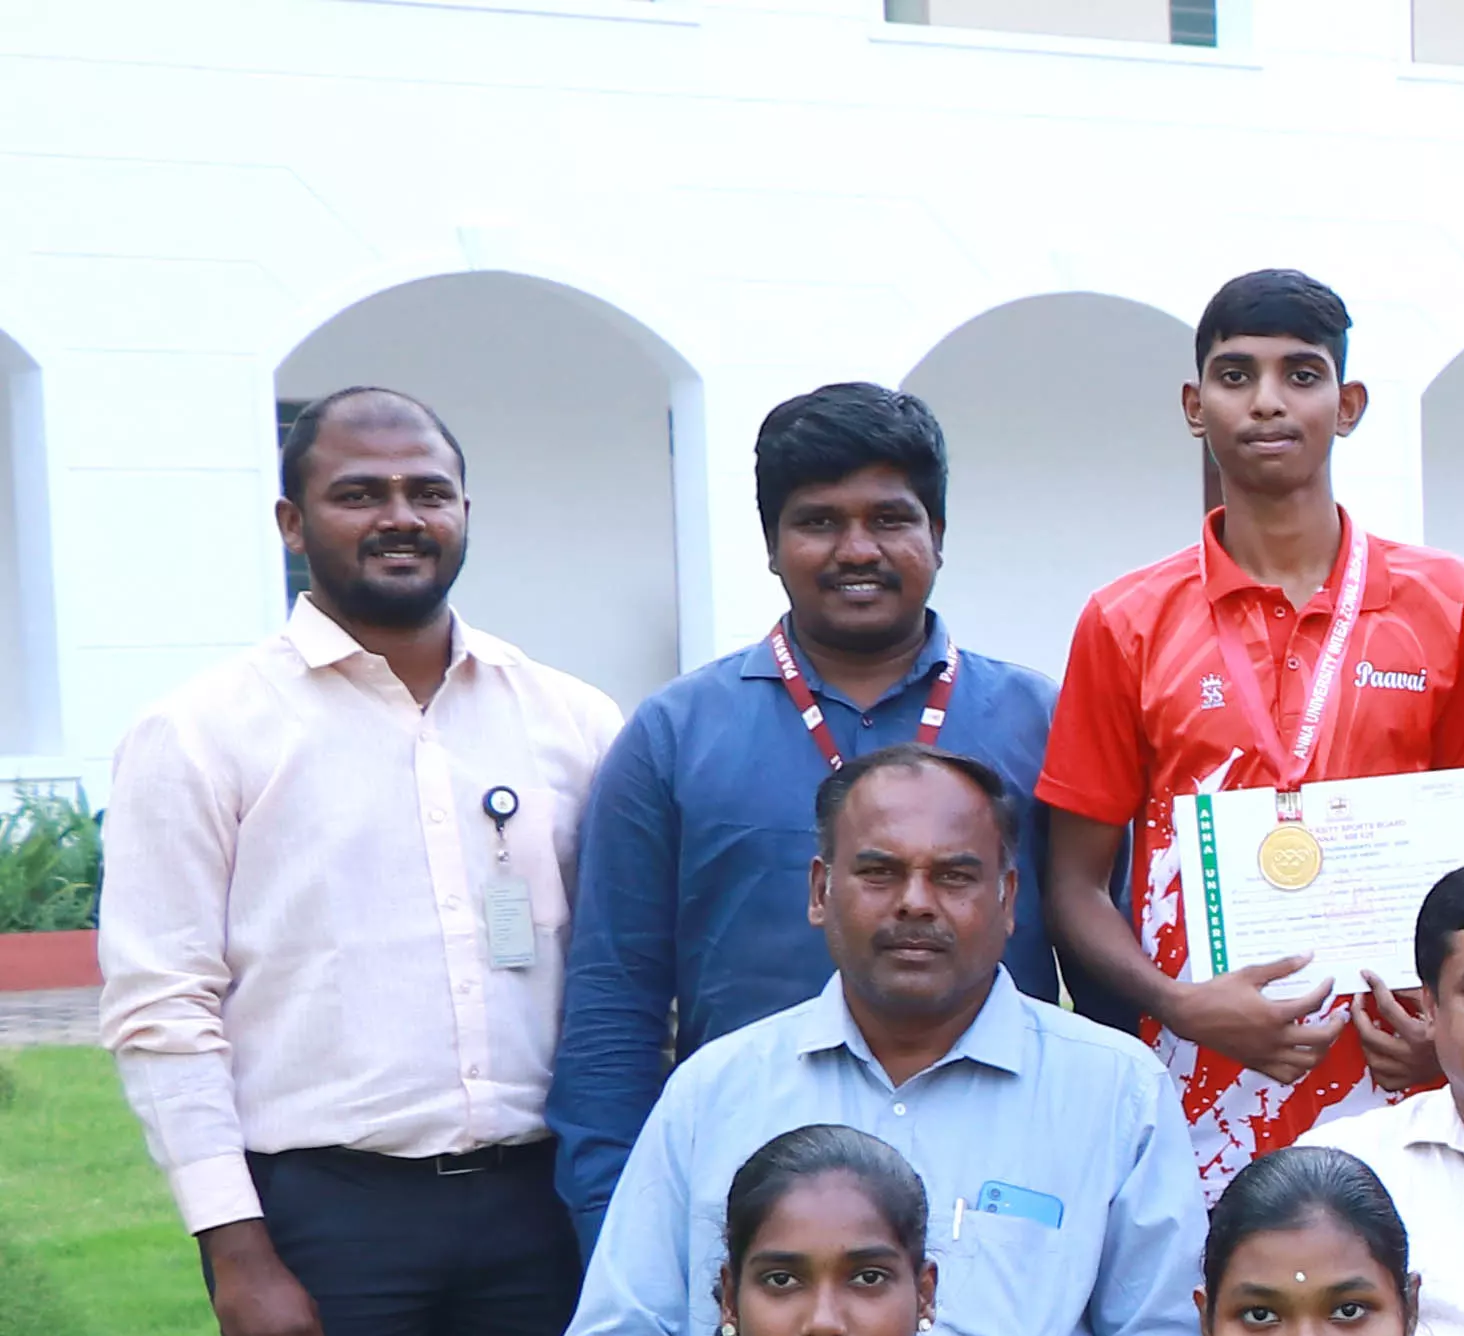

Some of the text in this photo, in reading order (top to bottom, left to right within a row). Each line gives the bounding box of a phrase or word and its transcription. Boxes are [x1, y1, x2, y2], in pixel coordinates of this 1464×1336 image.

[771, 633, 799, 680] PAAVAI
[1292, 724, 1315, 760] ANNA
[1306, 653, 1337, 726] UNIVERSITY
[1326, 619, 1349, 657] INTER
[1354, 660, 1428, 692] Paavai
[1205, 868, 1225, 974] UNIVERSIT
